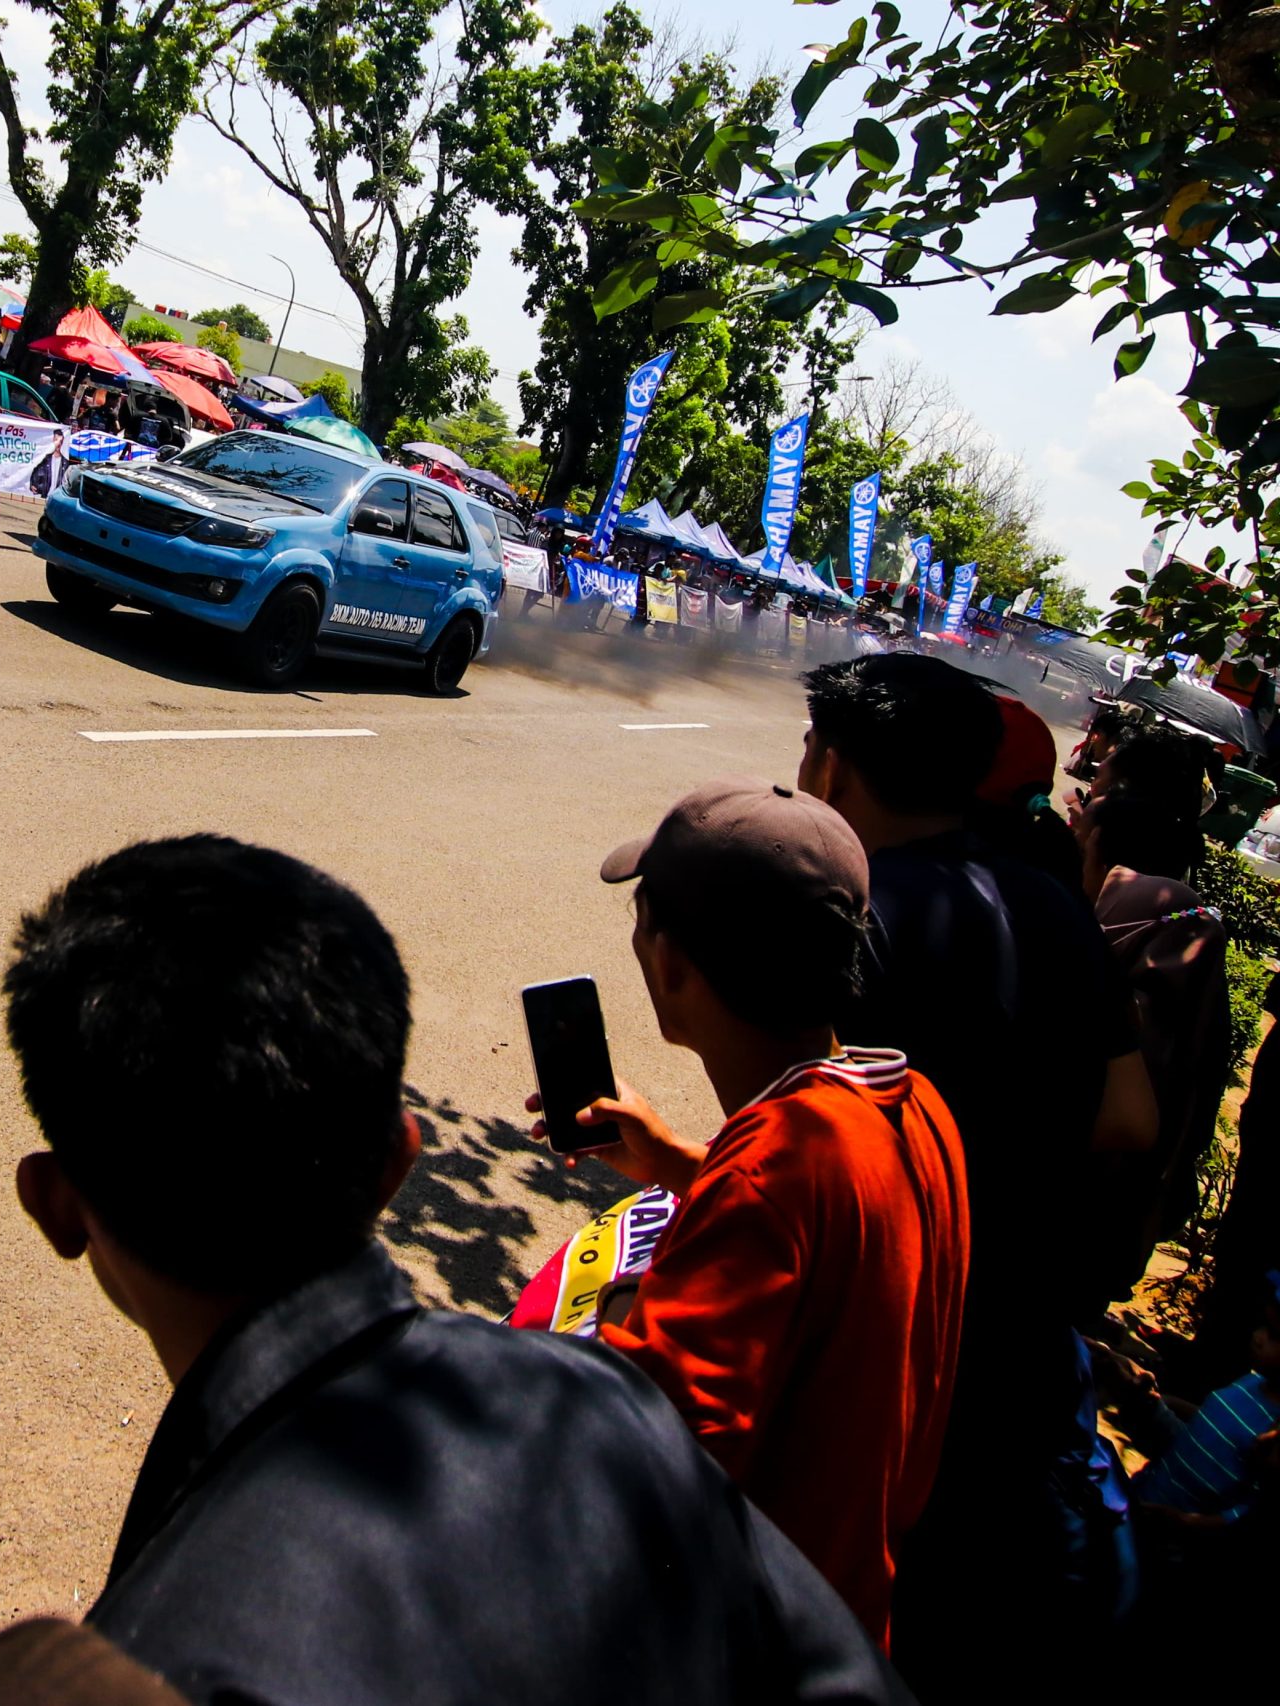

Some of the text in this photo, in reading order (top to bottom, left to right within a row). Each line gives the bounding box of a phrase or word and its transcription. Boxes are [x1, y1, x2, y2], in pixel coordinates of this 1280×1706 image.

[5, 425, 27, 439] Pas,
[381, 612, 409, 633] RACING
[406, 616, 426, 635] TEAM
